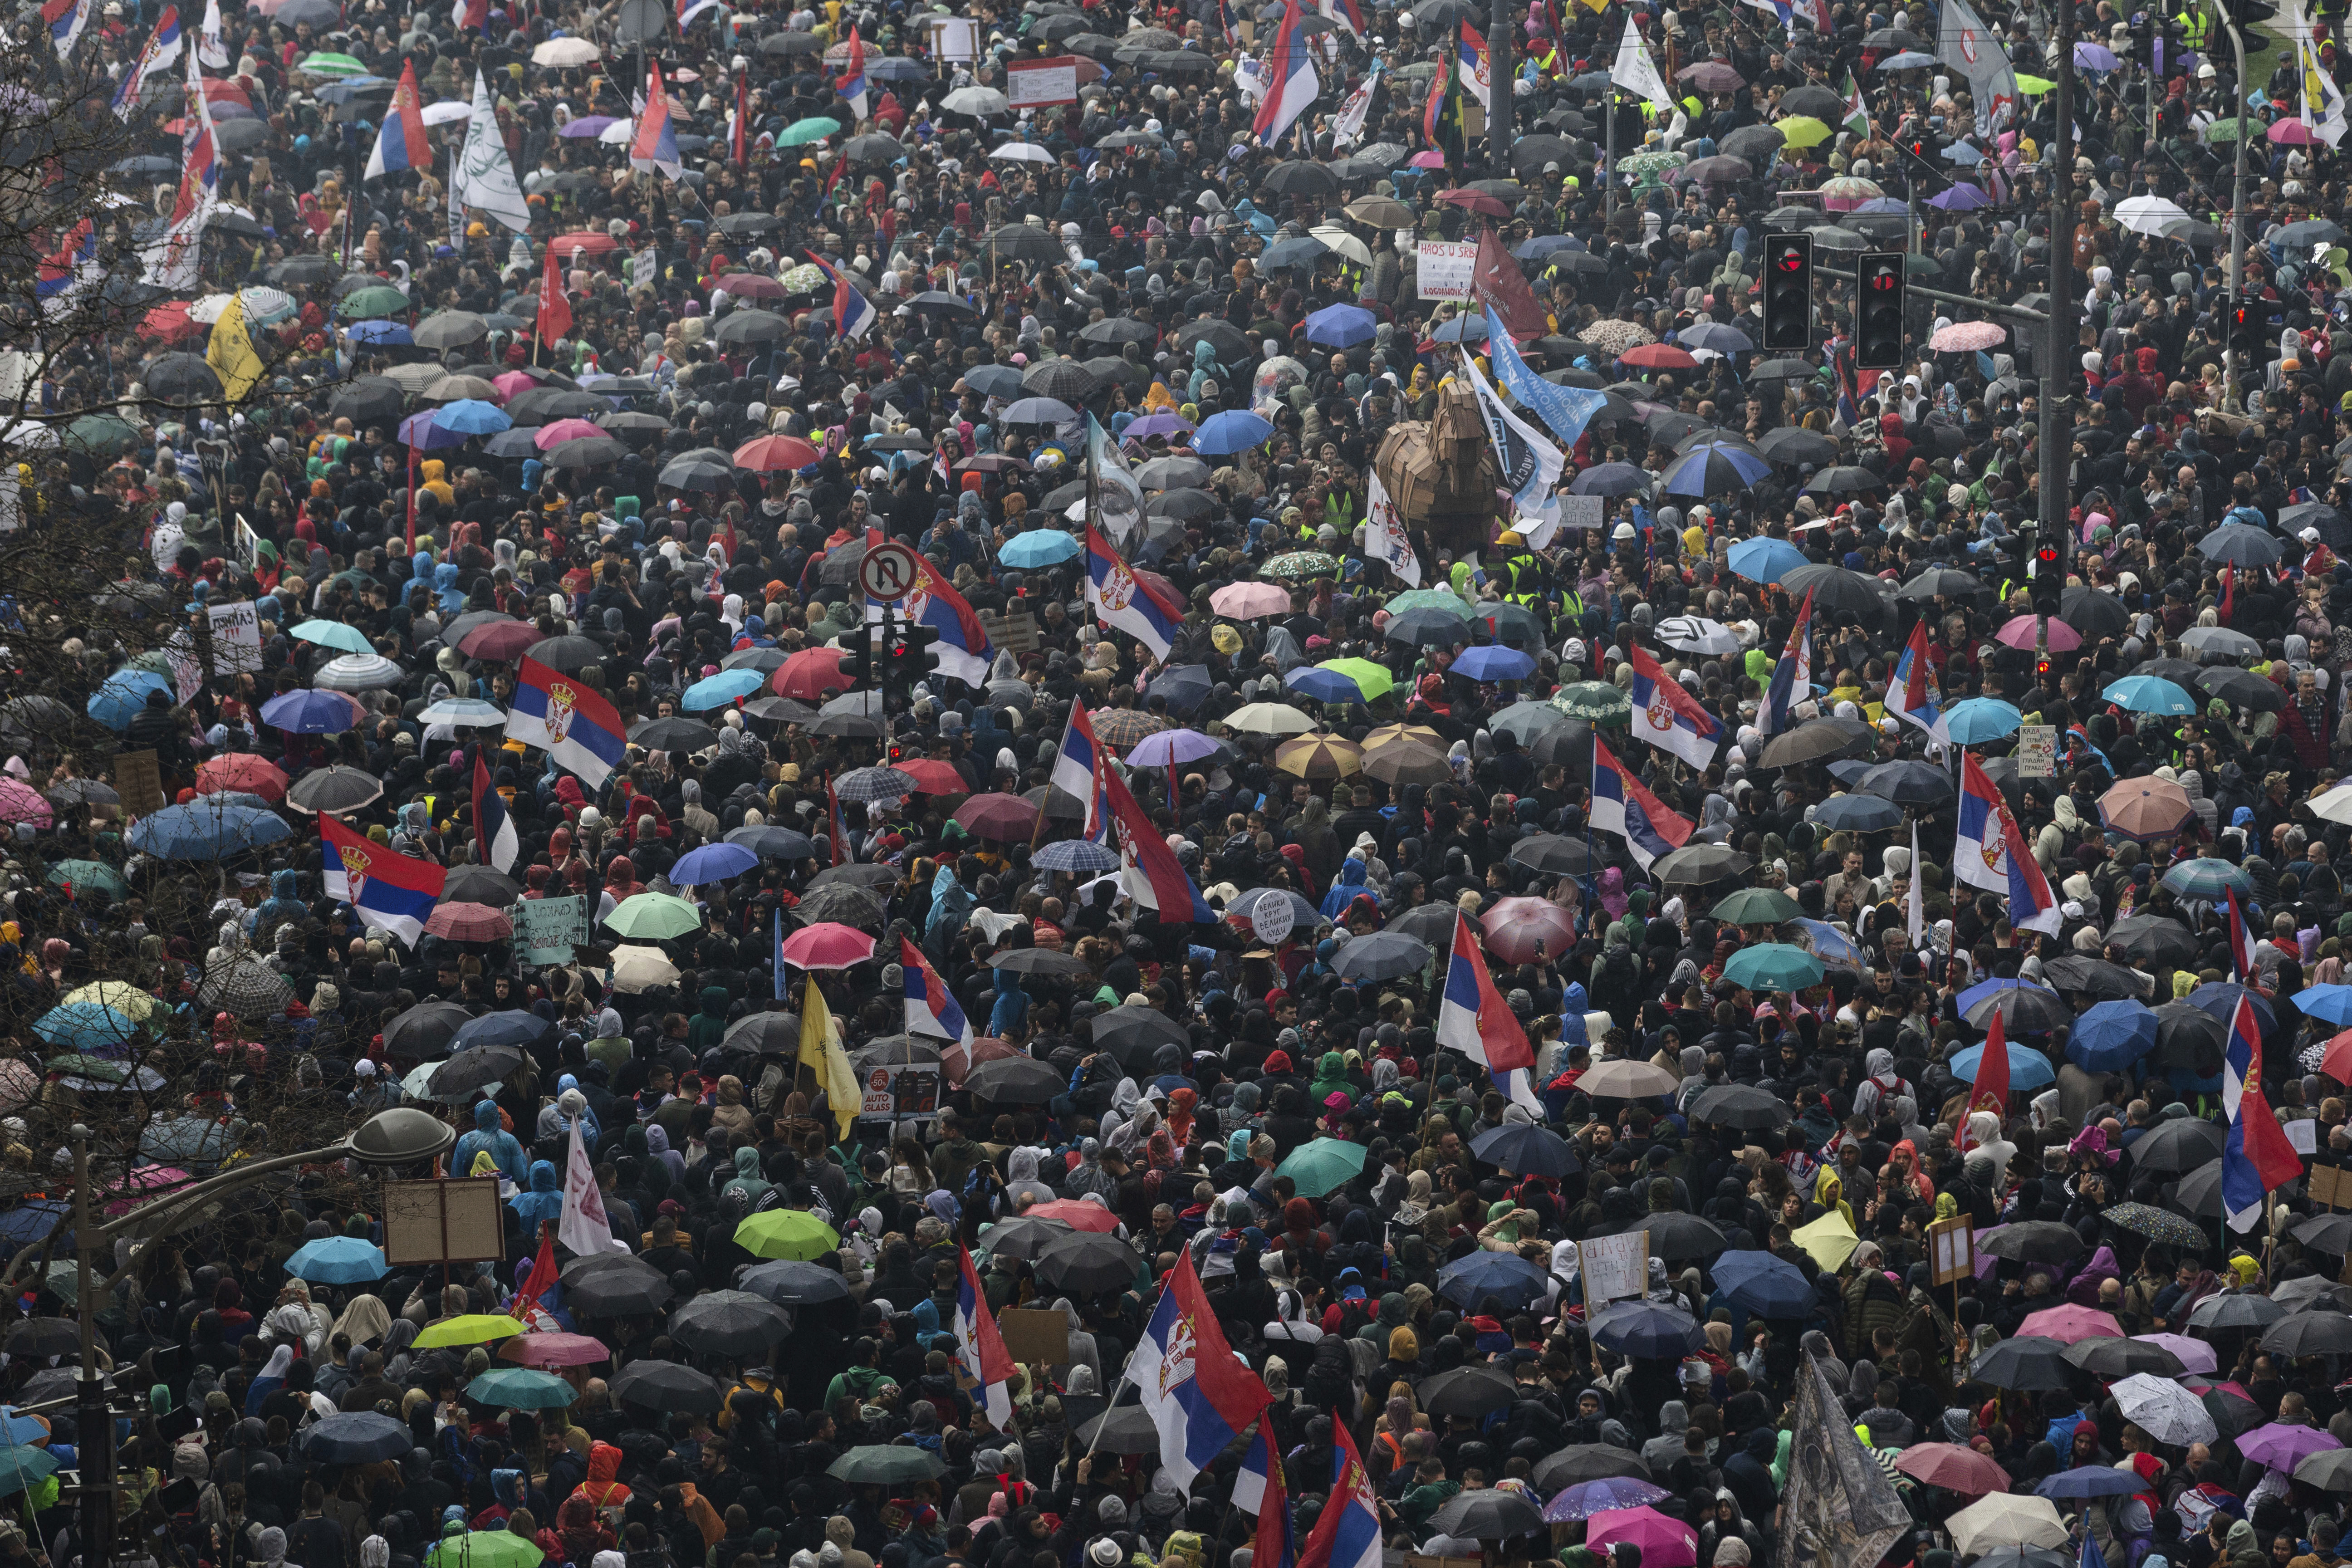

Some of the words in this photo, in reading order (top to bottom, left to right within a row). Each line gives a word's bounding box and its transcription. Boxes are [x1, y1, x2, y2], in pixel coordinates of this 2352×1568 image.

[1421, 244, 1445, 256] HAOS
[1449, 245, 1455, 256] U
[1580, 512, 1599, 524] BOL
[1259, 898, 1285, 912] ВЕЛИКИ
[1264, 908, 1280, 919] КРУГ
[1259, 914, 1292, 930] ВЕЛИКИХ
[1267, 926, 1286, 939] ЉУДИ
[871, 1078, 886, 1087] -50%
[865, 1094, 889, 1102] AUTO
[864, 1103, 890, 1112] GLASS
